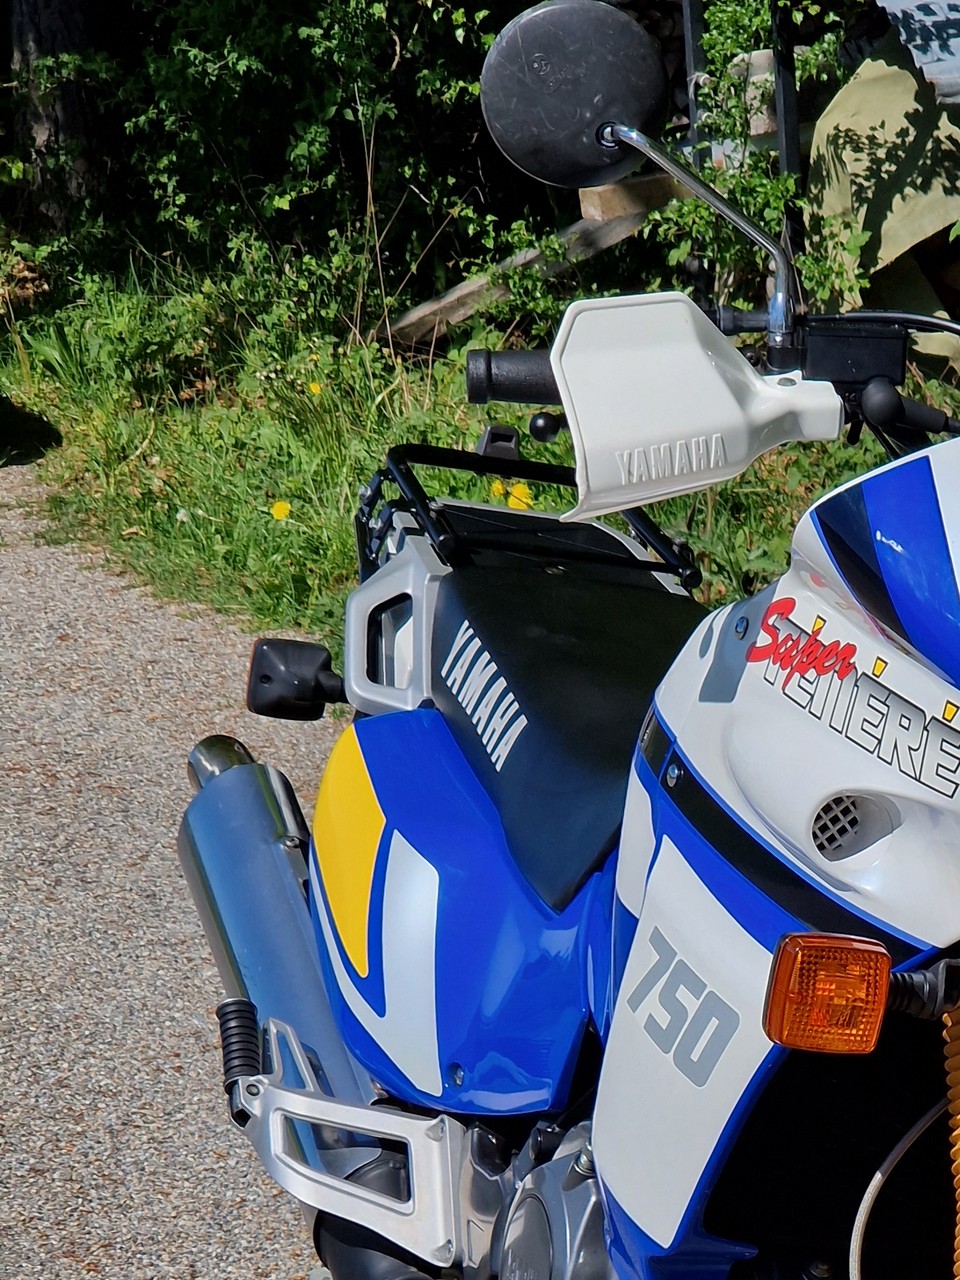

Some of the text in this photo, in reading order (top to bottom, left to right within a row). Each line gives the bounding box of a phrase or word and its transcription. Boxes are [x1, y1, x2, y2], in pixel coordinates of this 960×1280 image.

[613, 433, 727, 486] YAMAHA
[440, 619, 529, 772] YAMAHA
[745, 597, 857, 693] Super
[626, 925, 741, 1088] 750
